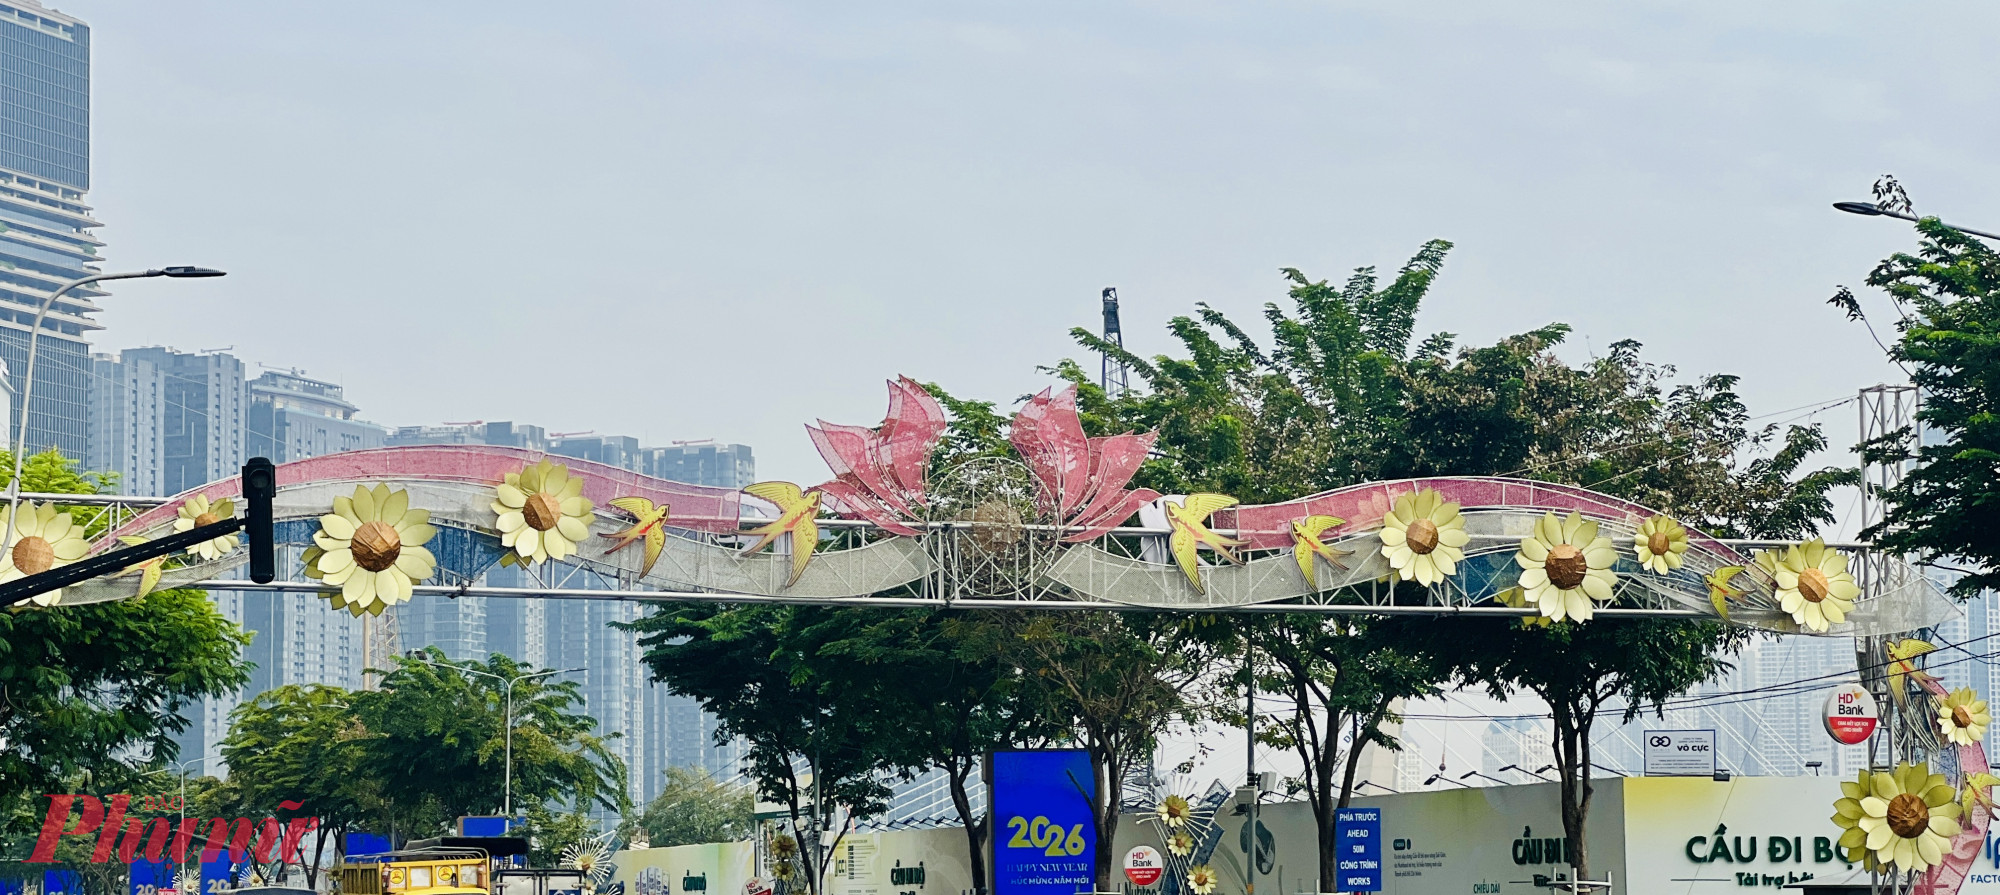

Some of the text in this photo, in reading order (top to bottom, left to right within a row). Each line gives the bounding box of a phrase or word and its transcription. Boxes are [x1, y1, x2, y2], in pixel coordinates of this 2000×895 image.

[1838, 693, 1853, 704] HD
[1838, 704, 1864, 715] Bank
[1339, 811, 1377, 821] PHÍA TRƯỚC
[1007, 815, 1086, 857] 2026
[1347, 829, 1368, 838] AHEAD
[1686, 822, 1757, 863] CẦU
[1768, 836, 1801, 863] ĐI
[1352, 845, 1365, 853] 50M
[1132, 852, 1144, 860] HD
[1040, 863, 1061, 872] NEW
[1063, 863, 1088, 872] YEAR
[1340, 859, 1378, 869] CÔNG TRÌNH
[1028, 875, 1053, 885] MỪNG
[1054, 875, 1072, 884] NĂM
[1073, 875, 1089, 884] MỚI
[1347, 877, 1371, 886] WORKS
[1736, 872, 1759, 886] Tài
[1762, 873, 1785, 890] trợ
[1971, 874, 2000, 884] FACT
